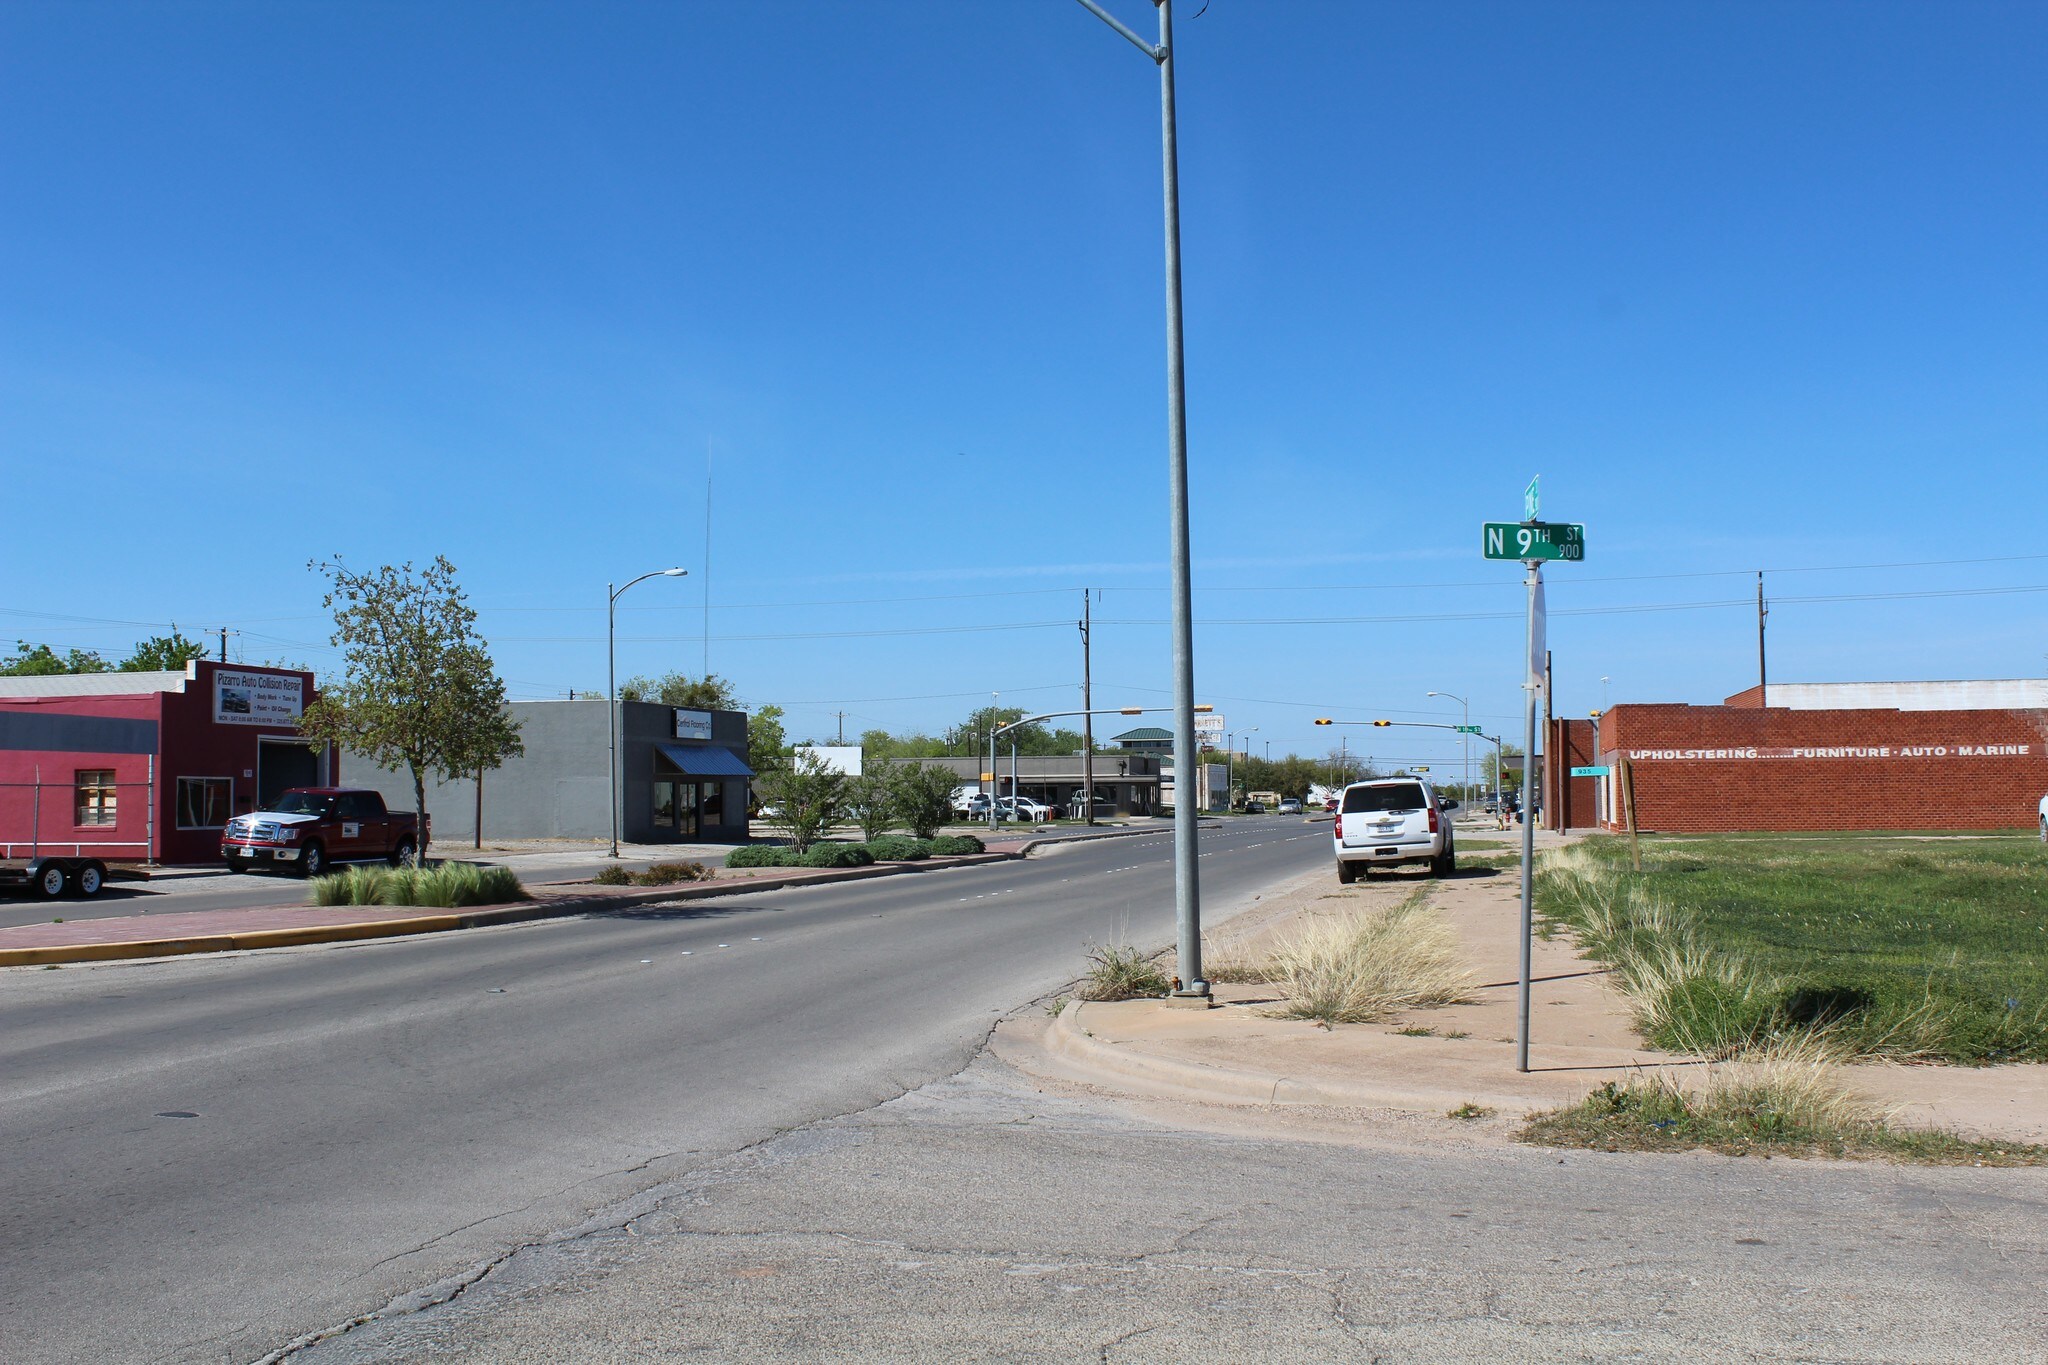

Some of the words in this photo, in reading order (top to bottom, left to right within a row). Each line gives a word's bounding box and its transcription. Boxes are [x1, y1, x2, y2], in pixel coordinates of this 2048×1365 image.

[1488, 528, 1504, 555] N
[1516, 528, 1550, 556] 9TH
[1566, 527, 1579, 541] ST
[1559, 544, 1579, 559] 900
[218, 673, 240, 686] Pizarro
[242, 676, 257, 688] Auto
[259, 677, 282, 690] Collision
[284, 679, 301, 691] Repair
[1793, 747, 1890, 758] FURNITURE
[1900, 746, 1947, 757] AUTO
[1958, 745, 2029, 756] MARINE
